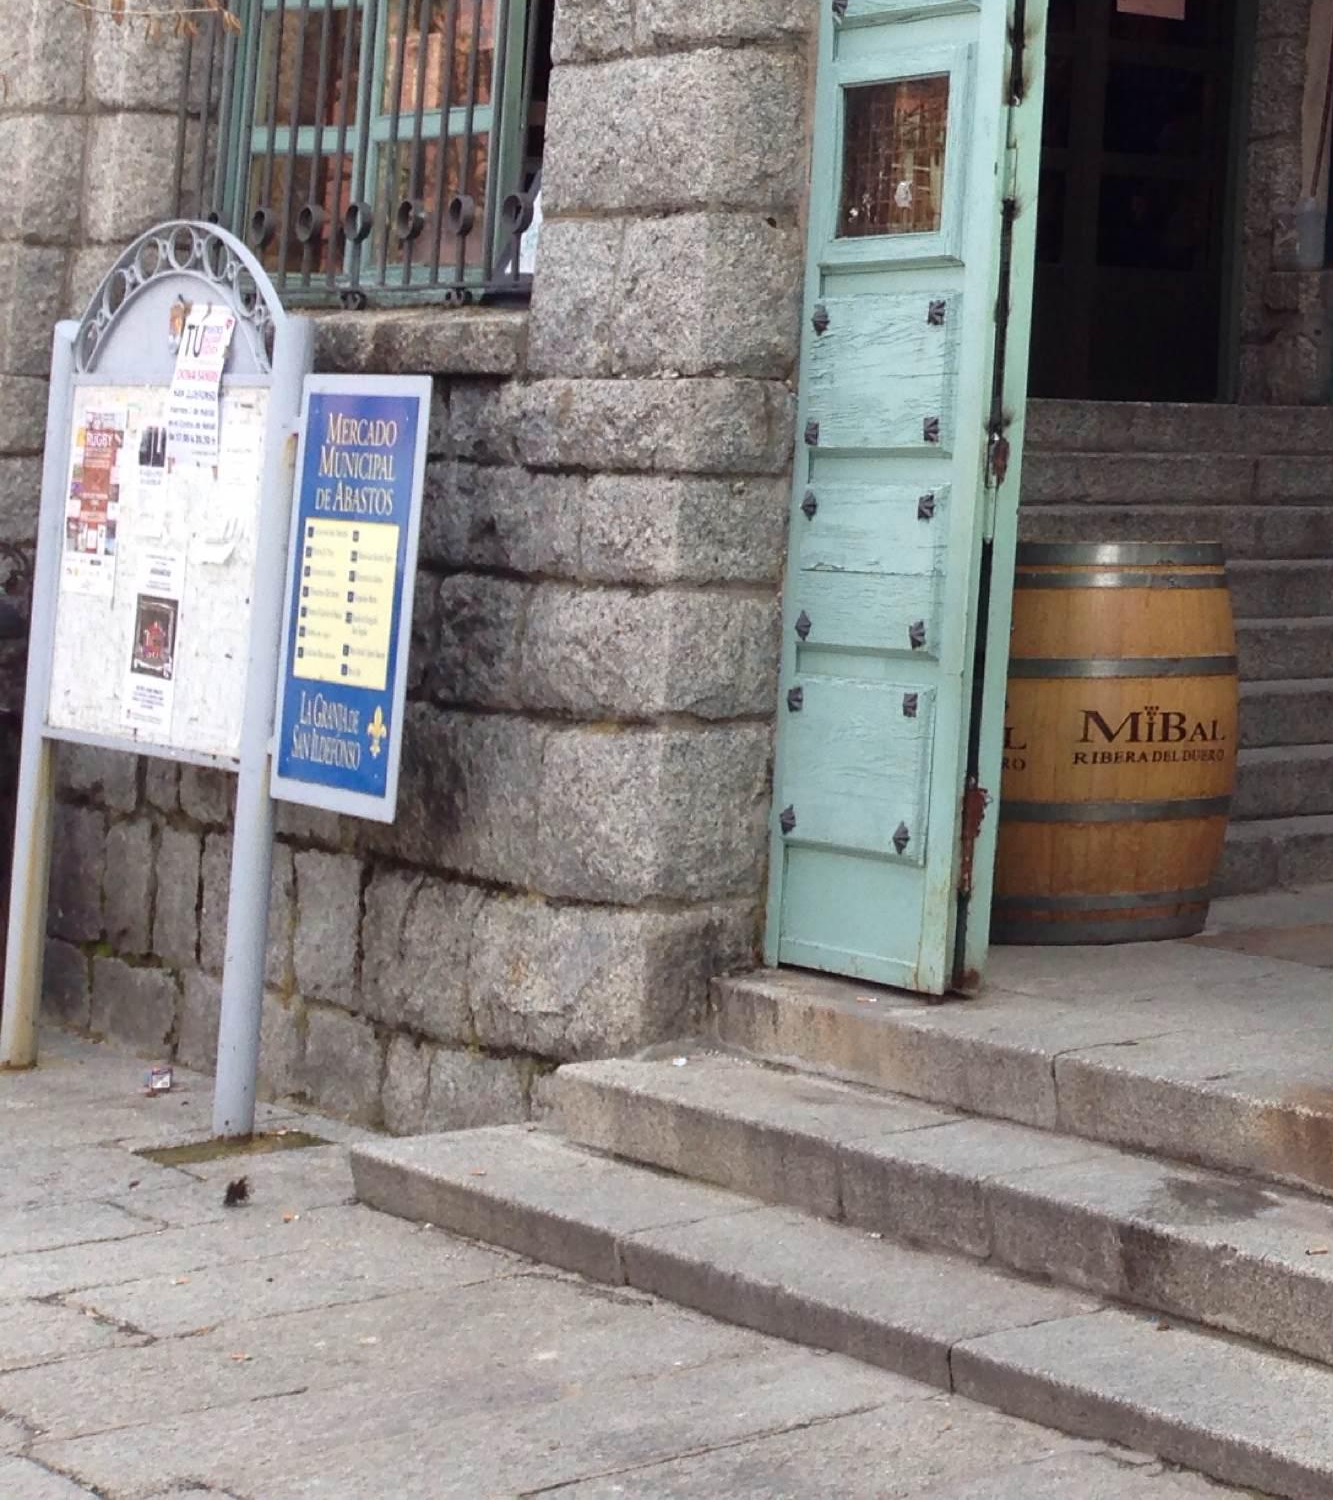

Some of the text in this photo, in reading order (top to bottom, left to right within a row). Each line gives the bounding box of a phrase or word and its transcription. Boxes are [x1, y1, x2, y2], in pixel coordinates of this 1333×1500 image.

[326, 412, 397, 448] MERCADO
[318, 444, 396, 481] MUNICIPAL
[332, 480, 394, 516] ABASTOS
[1074, 748, 1225, 765] RIBERA DEL DUERO
